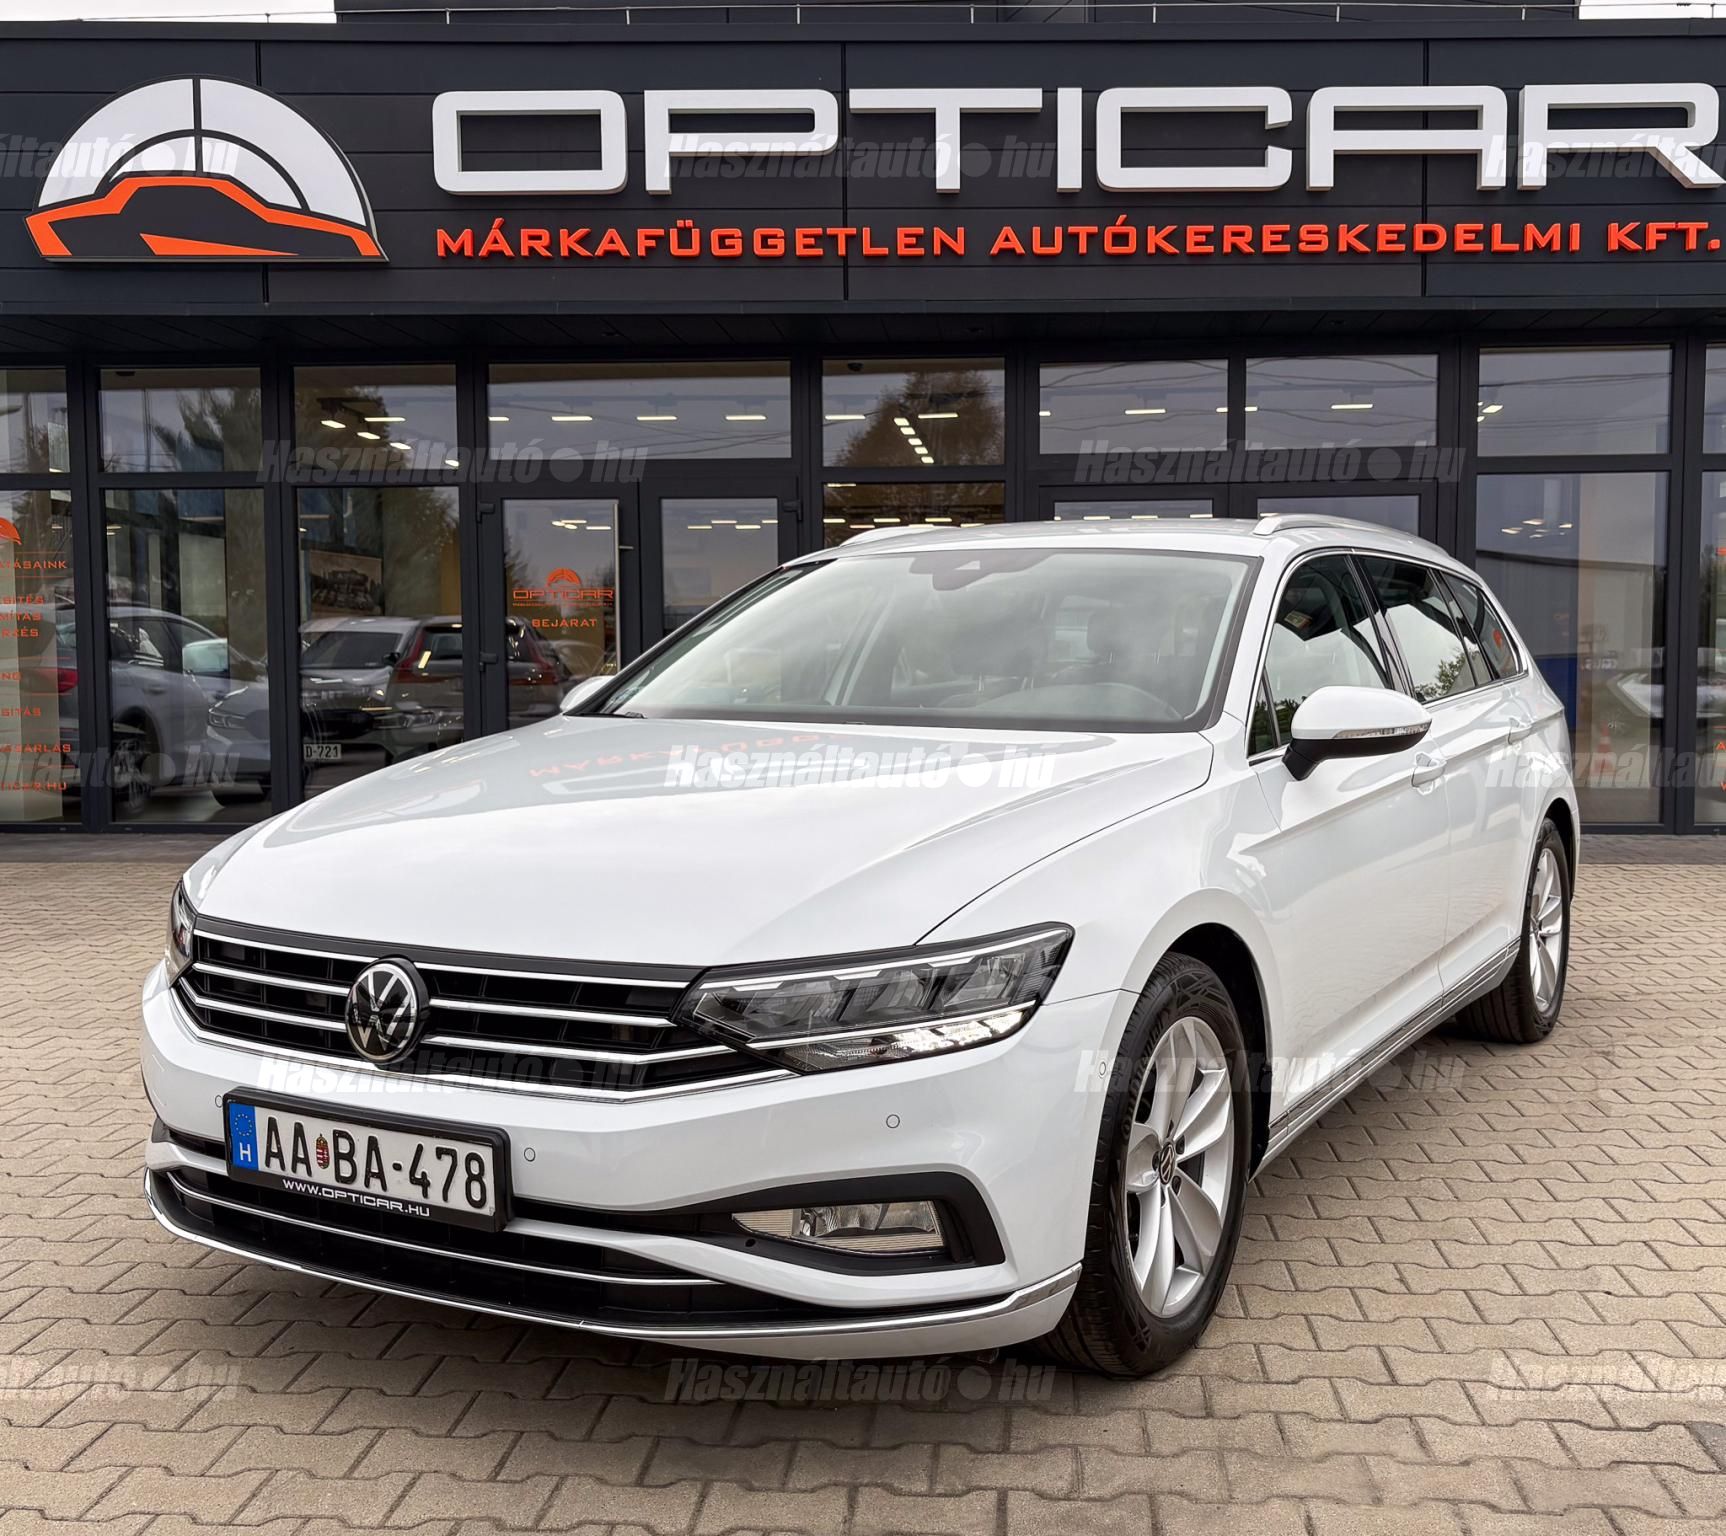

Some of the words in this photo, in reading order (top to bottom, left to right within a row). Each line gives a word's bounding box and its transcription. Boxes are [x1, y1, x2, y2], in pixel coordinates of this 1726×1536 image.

[431, 83, 1726, 196] OPTICAR
[436, 217, 966, 260] MÁRKAFÜGGETLEN
[989, 213, 1581, 257] AUTÓKERESKEDELMI
[1607, 220, 1721, 253] KFT.
[513, 589, 614, 600] OPTICAR
[239, 1143, 251, 1163] H
[264, 1116, 312, 1178] AA
[332, 1129, 488, 1210] BA-478
[282, 1178, 430, 1218] WWW.OPTICAR.HU
